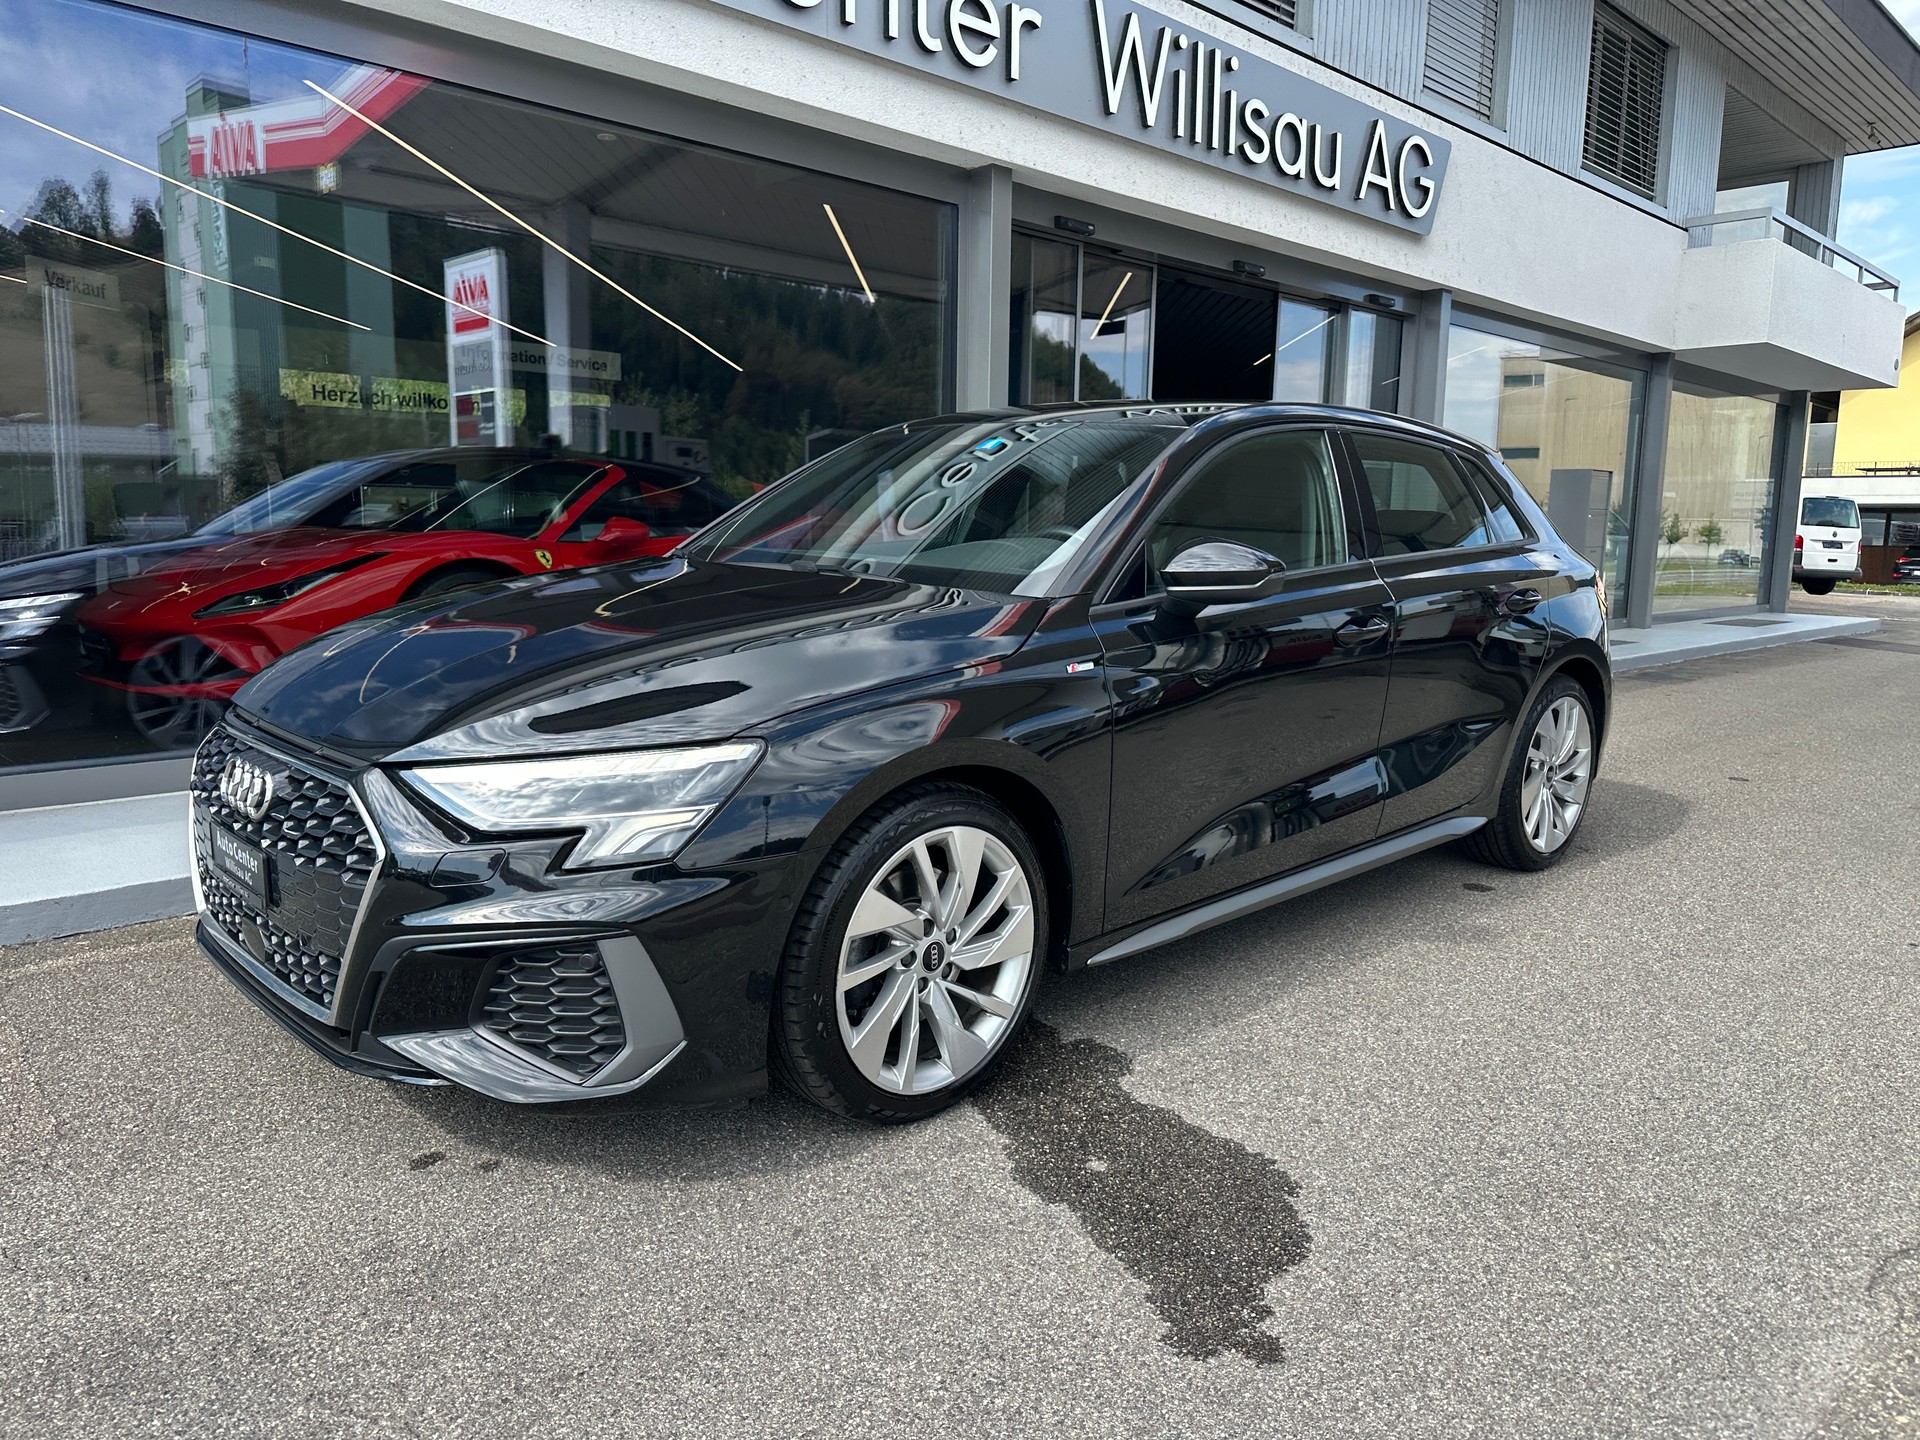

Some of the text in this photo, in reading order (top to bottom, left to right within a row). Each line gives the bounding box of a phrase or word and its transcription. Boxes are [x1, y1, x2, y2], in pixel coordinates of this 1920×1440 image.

[1093, 0, 1343, 191] Willisau
[1355, 118, 1436, 219] AG
[44, 269, 107, 300] Verkauf
[556, 353, 608, 373] Service
[216, 830, 258, 874] AutoCenter
